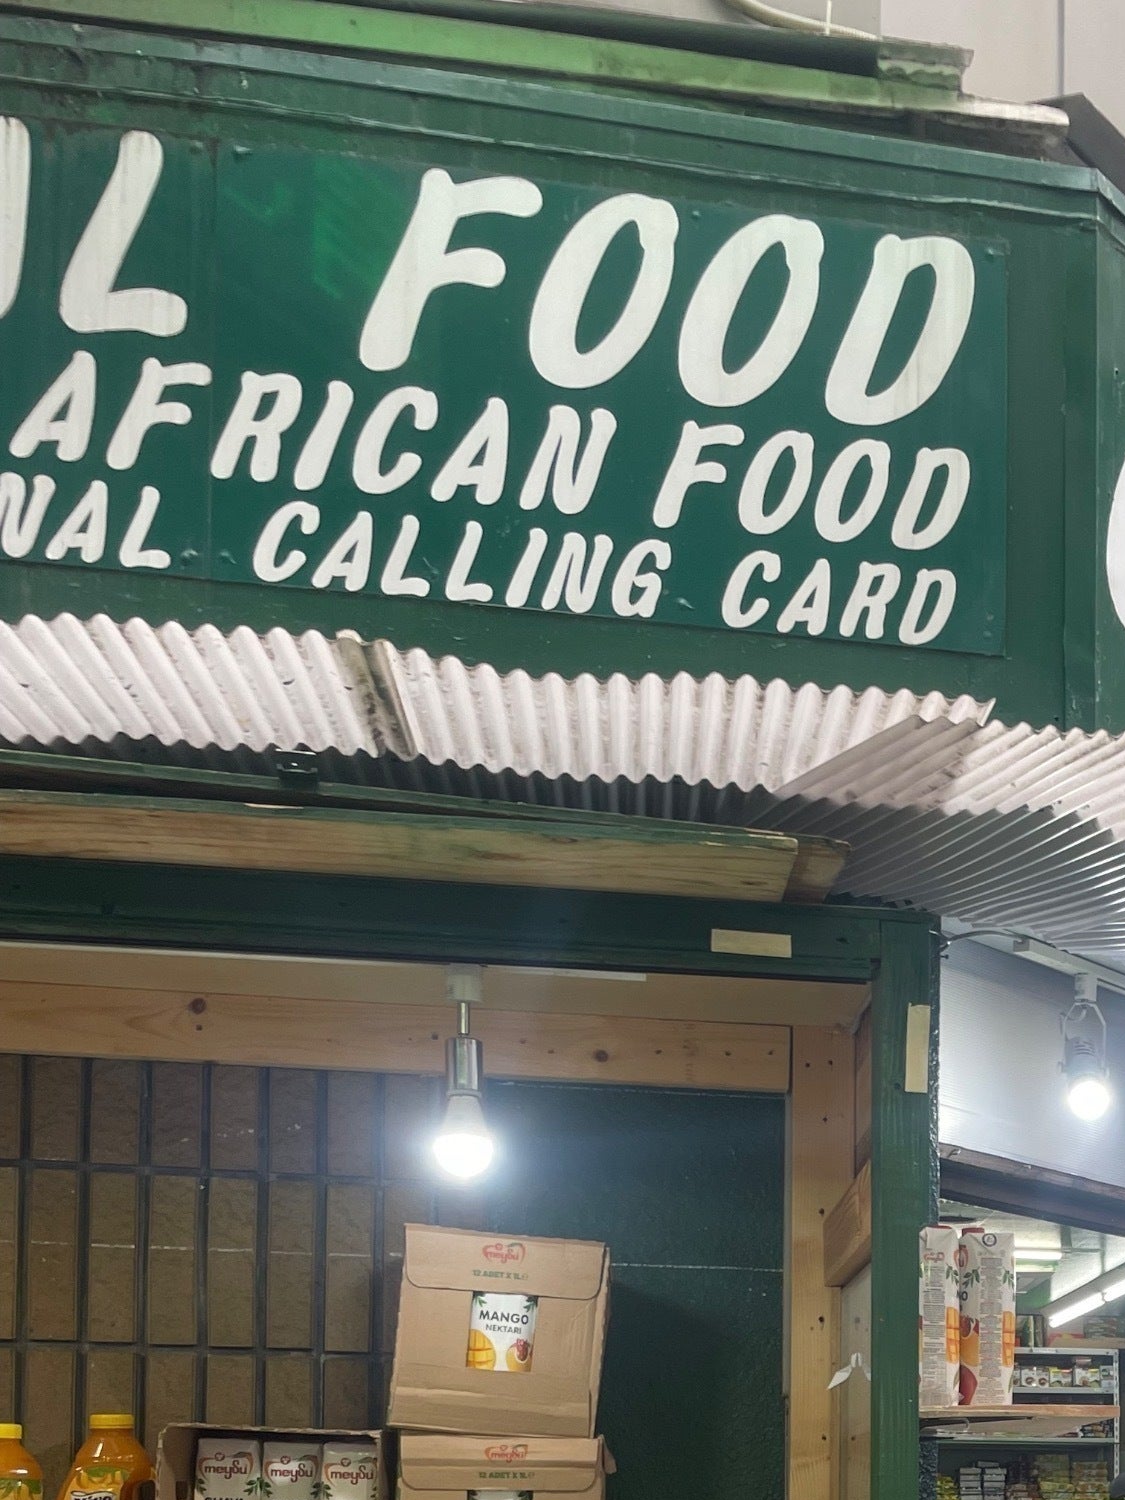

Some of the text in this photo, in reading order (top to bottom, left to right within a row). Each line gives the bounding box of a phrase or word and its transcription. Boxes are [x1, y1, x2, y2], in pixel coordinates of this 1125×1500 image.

[359, 167, 976, 427] FOOD
[9, 350, 971, 552] AFRICAN FOOD
[253, 499, 671, 619] CALLING
[722, 550, 957, 646] CARD
[479, 1309, 529, 1325] MANGO
[485, 1324, 522, 1334] NEKTARI
